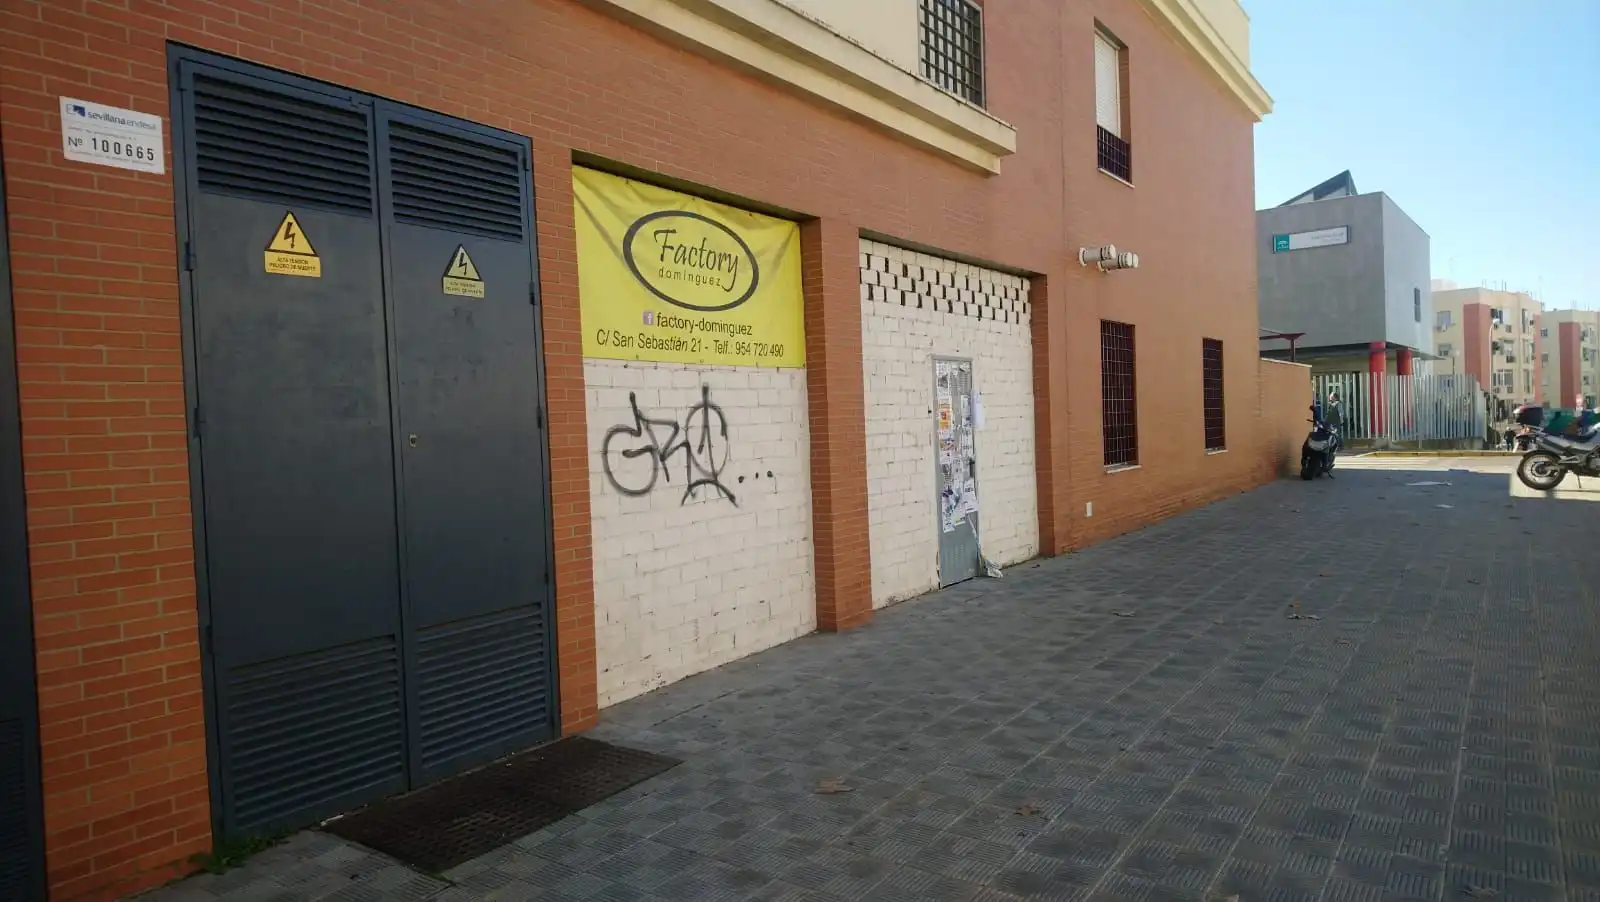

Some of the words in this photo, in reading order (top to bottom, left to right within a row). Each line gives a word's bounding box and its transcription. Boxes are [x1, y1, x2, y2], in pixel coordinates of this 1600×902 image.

[87, 111, 126, 125] sevillana
[92, 138, 155, 161] 100665
[653, 228, 738, 292] Factory
[656, 312, 753, 337] factory-dominguez
[596, 328, 610, 347] C/
[612, 330, 634, 348] San
[637, 332, 689, 352] Sebastián
[690, 337, 702, 353] 21
[735, 341, 751, 356] 954
[753, 343, 768, 357] 720
[769, 343, 784, 358] 490
